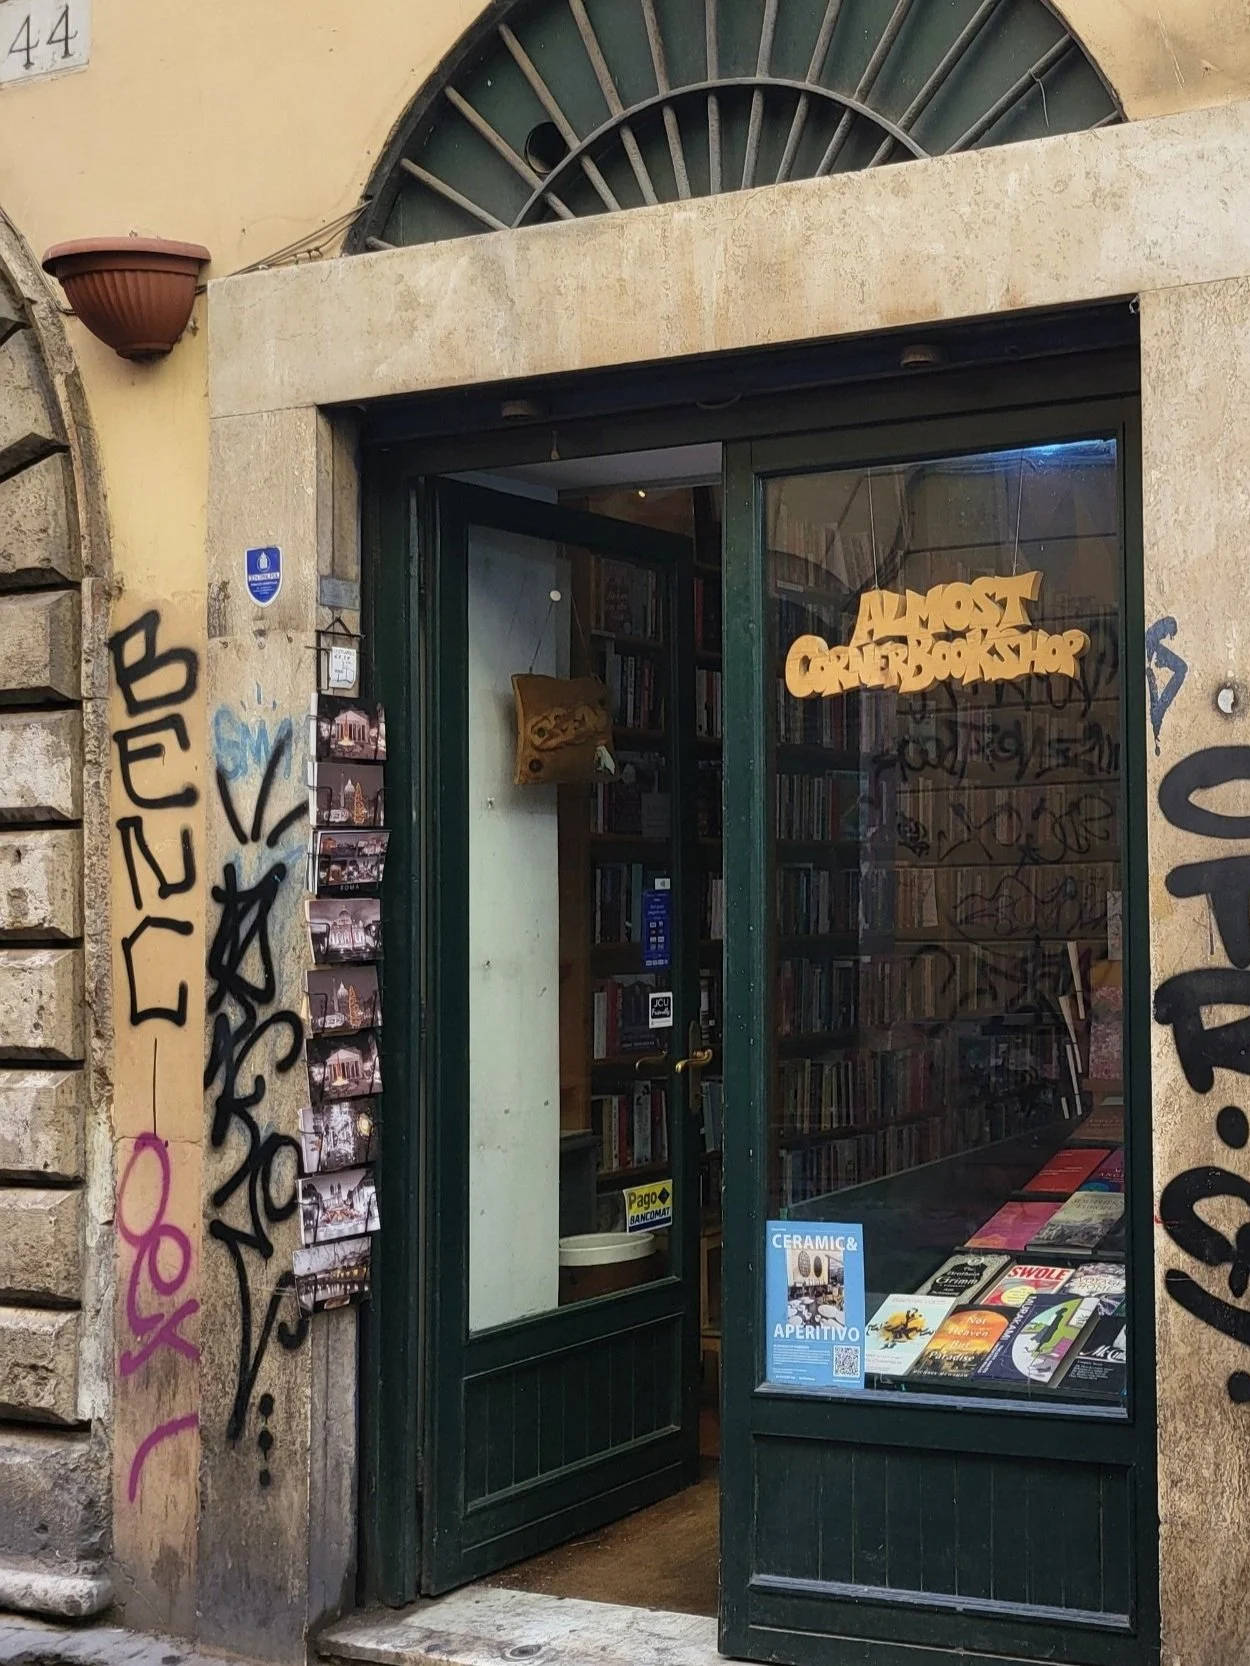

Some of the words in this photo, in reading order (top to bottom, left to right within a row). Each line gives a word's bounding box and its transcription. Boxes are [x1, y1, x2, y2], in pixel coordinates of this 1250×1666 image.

[850, 571, 1043, 648] ALMOST
[653, 999, 669, 1008] JCU
[628, 1191, 658, 1210] Pago
[629, 1207, 671, 1225] BANCOMAT
[936, 1276, 978, 1285] Grimm
[1008, 1266, 1069, 1280] SWOLE
[773, 1324, 860, 1342] APERITIVO
[929, 1351, 975, 1362] Paradise
